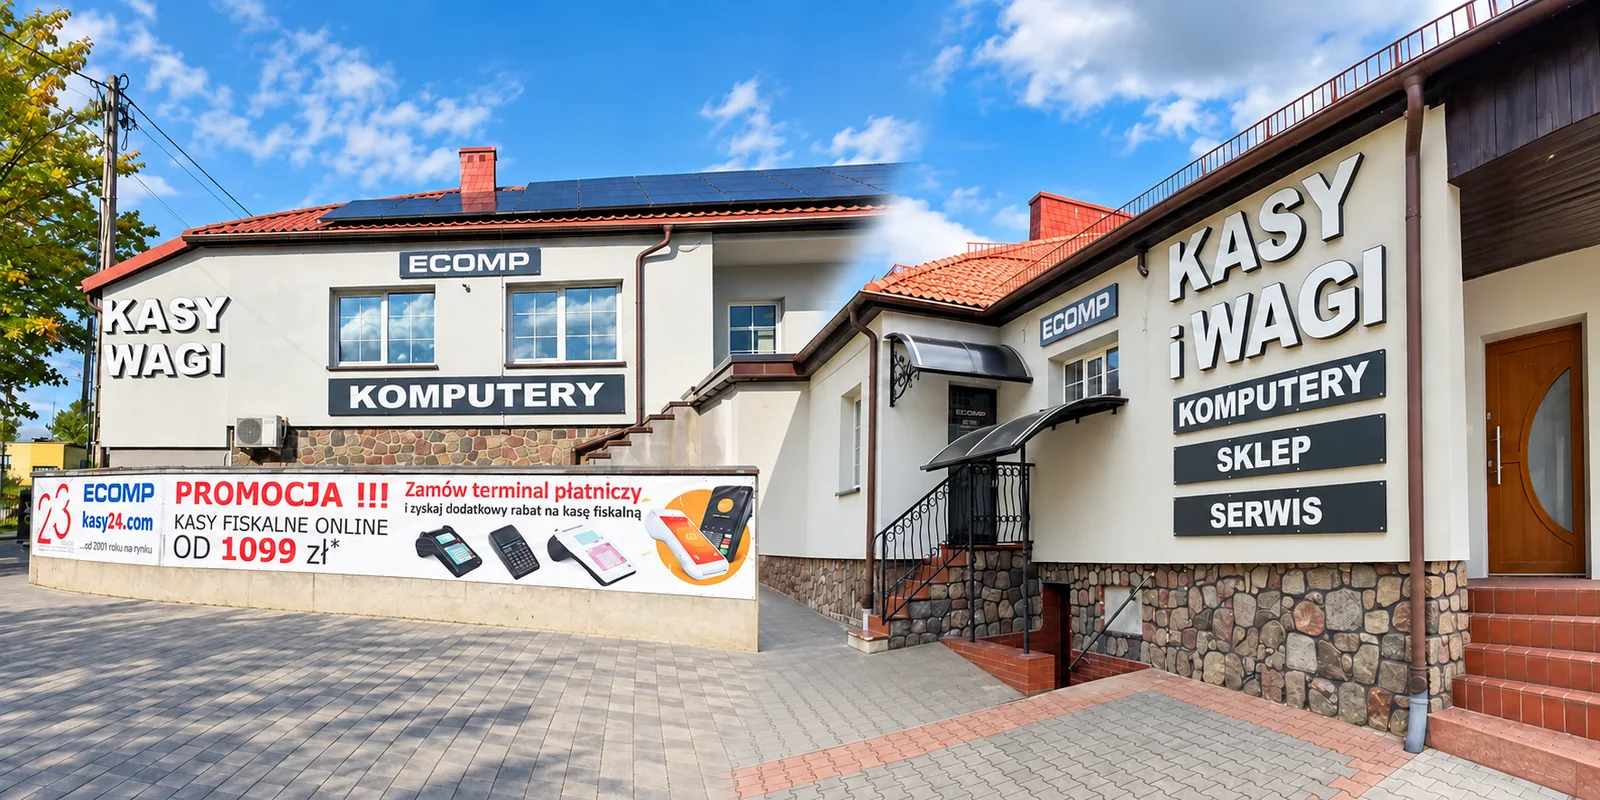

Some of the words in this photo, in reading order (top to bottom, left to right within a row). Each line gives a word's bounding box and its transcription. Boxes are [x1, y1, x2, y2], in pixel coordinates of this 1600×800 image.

[1169, 152, 1365, 303] KASY
[408, 252, 531, 274] ECOMP
[102, 296, 232, 335] KASY
[1042, 291, 1110, 341] ECOMP
[1170, 325, 1185, 380] i
[1190, 244, 1387, 372] WAGI
[103, 342, 226, 379] WAGI
[349, 381, 605, 410] KOMPUTERY
[1178, 360, 1370, 427] KOMPUTERY
[955, 408, 986, 417] ECOMP
[1216, 435, 1311, 473] SKLEP
[83, 483, 155, 503] ECOMP
[175, 481, 343, 507] PROMOCJA
[357, 482, 389, 509] !!!
[404, 480, 468, 498] Zamów
[472, 481, 549, 499] terminal
[555, 481, 642, 504] płatniczy
[82, 511, 153, 534] kasy24.com
[174, 514, 217, 530] KASY
[223, 515, 309, 533] FISKALNE
[315, 517, 388, 536] ONLINE
[404, 502, 408, 513] i
[410, 502, 443, 516] zyskaj
[446, 503, 508, 517] dodatkowy
[511, 504, 542, 516] rabat
[545, 508, 559, 516] na
[563, 505, 590, 520] kasę
[593, 505, 642, 521] fiskalną
[1210, 496, 1323, 529] SERWIS
[93, 541, 108, 551] 2001
[108, 543, 123, 553] roku
[124, 545, 133, 553] na
[134, 545, 153, 556] rynku
[173, 534, 211, 559] OD
[222, 536, 297, 564] 1099
